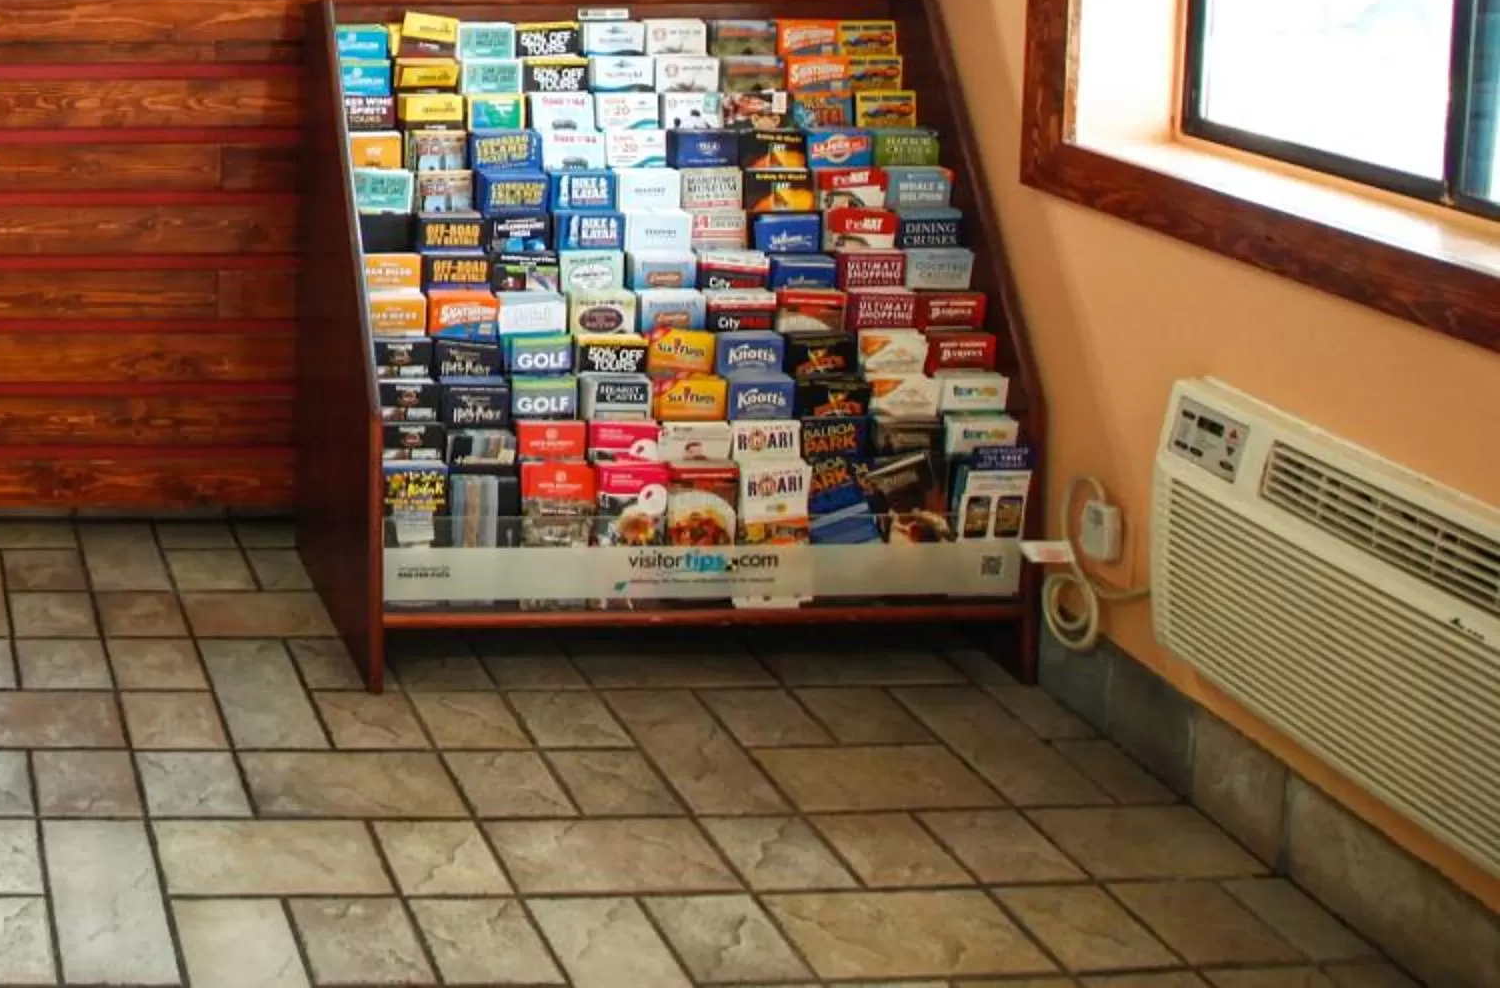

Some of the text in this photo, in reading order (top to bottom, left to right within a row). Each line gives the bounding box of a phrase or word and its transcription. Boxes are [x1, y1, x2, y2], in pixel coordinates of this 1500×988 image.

[521, 32, 548, 45] 50%
[550, 31, 571, 44] OFF
[528, 43, 567, 55] TOURS
[533, 68, 560, 82] 50%
[561, 67, 585, 80] OFF
[539, 78, 579, 90] TOURS
[571, 177, 598, 189] BIKE
[581, 217, 608, 229] BIKE
[905, 223, 956, 233] DINING
[903, 236, 957, 246] CRUISES
[847, 262, 901, 271] ULTIMATE
[847, 270, 901, 279] SHOPPING
[859, 300, 914, 310] ULTIMATE
[858, 310, 913, 320] SHOPPING
[588, 346, 645, 361] 50% OFF
[728, 343, 777, 365] Knott's
[517, 352, 568, 369] GOLF
[593, 360, 637, 372] TOURS
[516, 396, 569, 413] GOLF
[737, 388, 786, 409] Knott's
[804, 423, 856, 440] BALBOA
[805, 435, 856, 453] PARK
[628, 549, 780, 572] visitortips.com
